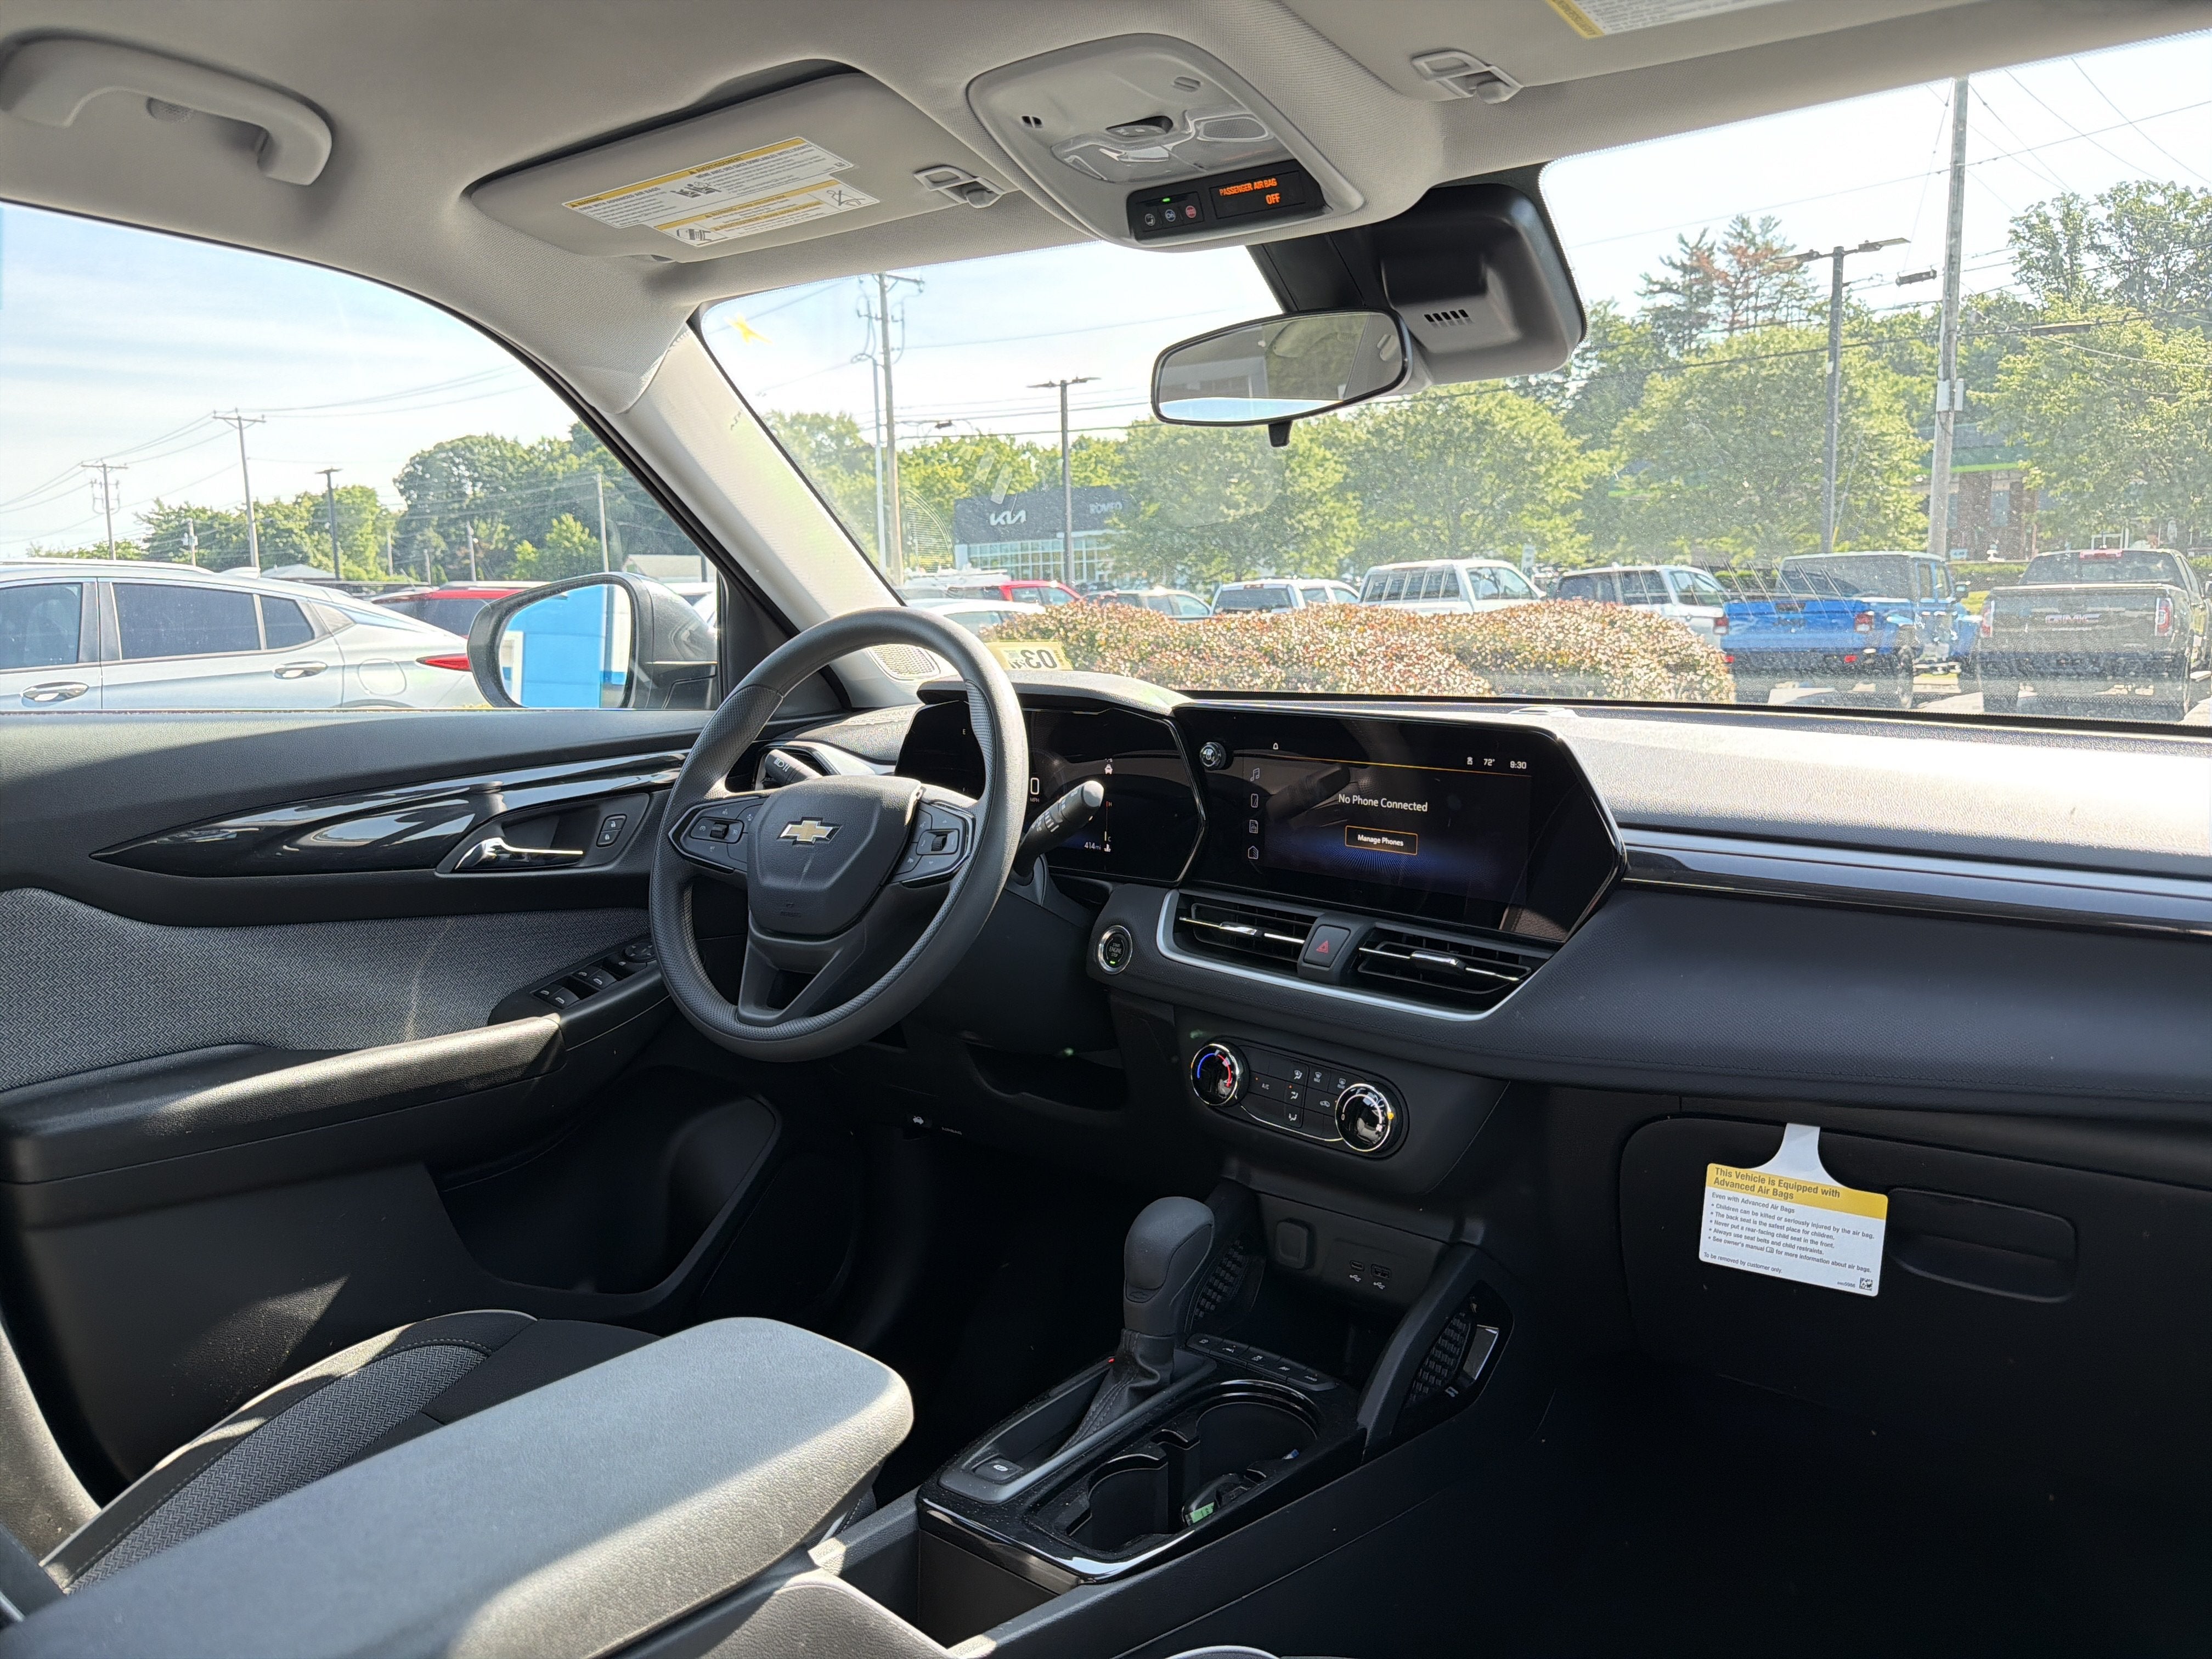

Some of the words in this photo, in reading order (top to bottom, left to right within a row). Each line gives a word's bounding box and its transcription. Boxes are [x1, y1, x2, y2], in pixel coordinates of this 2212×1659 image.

[1219, 183, 1254, 196] PASSENGER
[1254, 180, 1265, 190] AIR
[1263, 178, 1278, 188] BAG
[1266, 193, 1280, 205] OFF
[2045, 613, 2102, 624] GMC
[1510, 760, 1527, 769] 9:30
[1030, 777, 1040, 795] 0
[1338, 794, 1351, 804] No
[1352, 795, 1379, 807] Phone
[1380, 798, 1429, 812] Connected
[1357, 834, 1381, 844] Manage
[1381, 837, 1404, 847] Phones
[1713, 1177, 1756, 1192] Advanced
[1758, 1186, 1770, 1195] Air
[1773, 1188, 1794, 1200] Bags
[1715, 1167, 1733, 1179] This
[1735, 1171, 1766, 1184] Vehicle
[1768, 1177, 1776, 1186] is
[1778, 1180, 1819, 1195] Equipped
[1820, 1188, 1840, 1198] with
[1712, 1192, 1726, 1200] Even
[1740, 1198, 1769, 1209] Advanced
[1780, 1205, 1795, 1214] Bags
[1716, 1203, 1739, 1213] Children
[1759, 1212, 1776, 1220] killed
[1784, 1217, 1810, 1228] seriously
[1811, 1222, 1831, 1231] injured
[1713, 1228, 1732, 1237] Always
[1756, 1236, 1770, 1244] belts
[1714, 1219, 1730, 1227] Never
[1745, 1227, 1775, 1238] rear-facing
[1723, 1239, 1745, 1248] owner's
[1799, 1253, 1830, 1265] information
[1831, 1260, 1847, 1268] about
[1717, 1256, 1739, 1265] removed
[1746, 1262, 1770, 1271] customer
